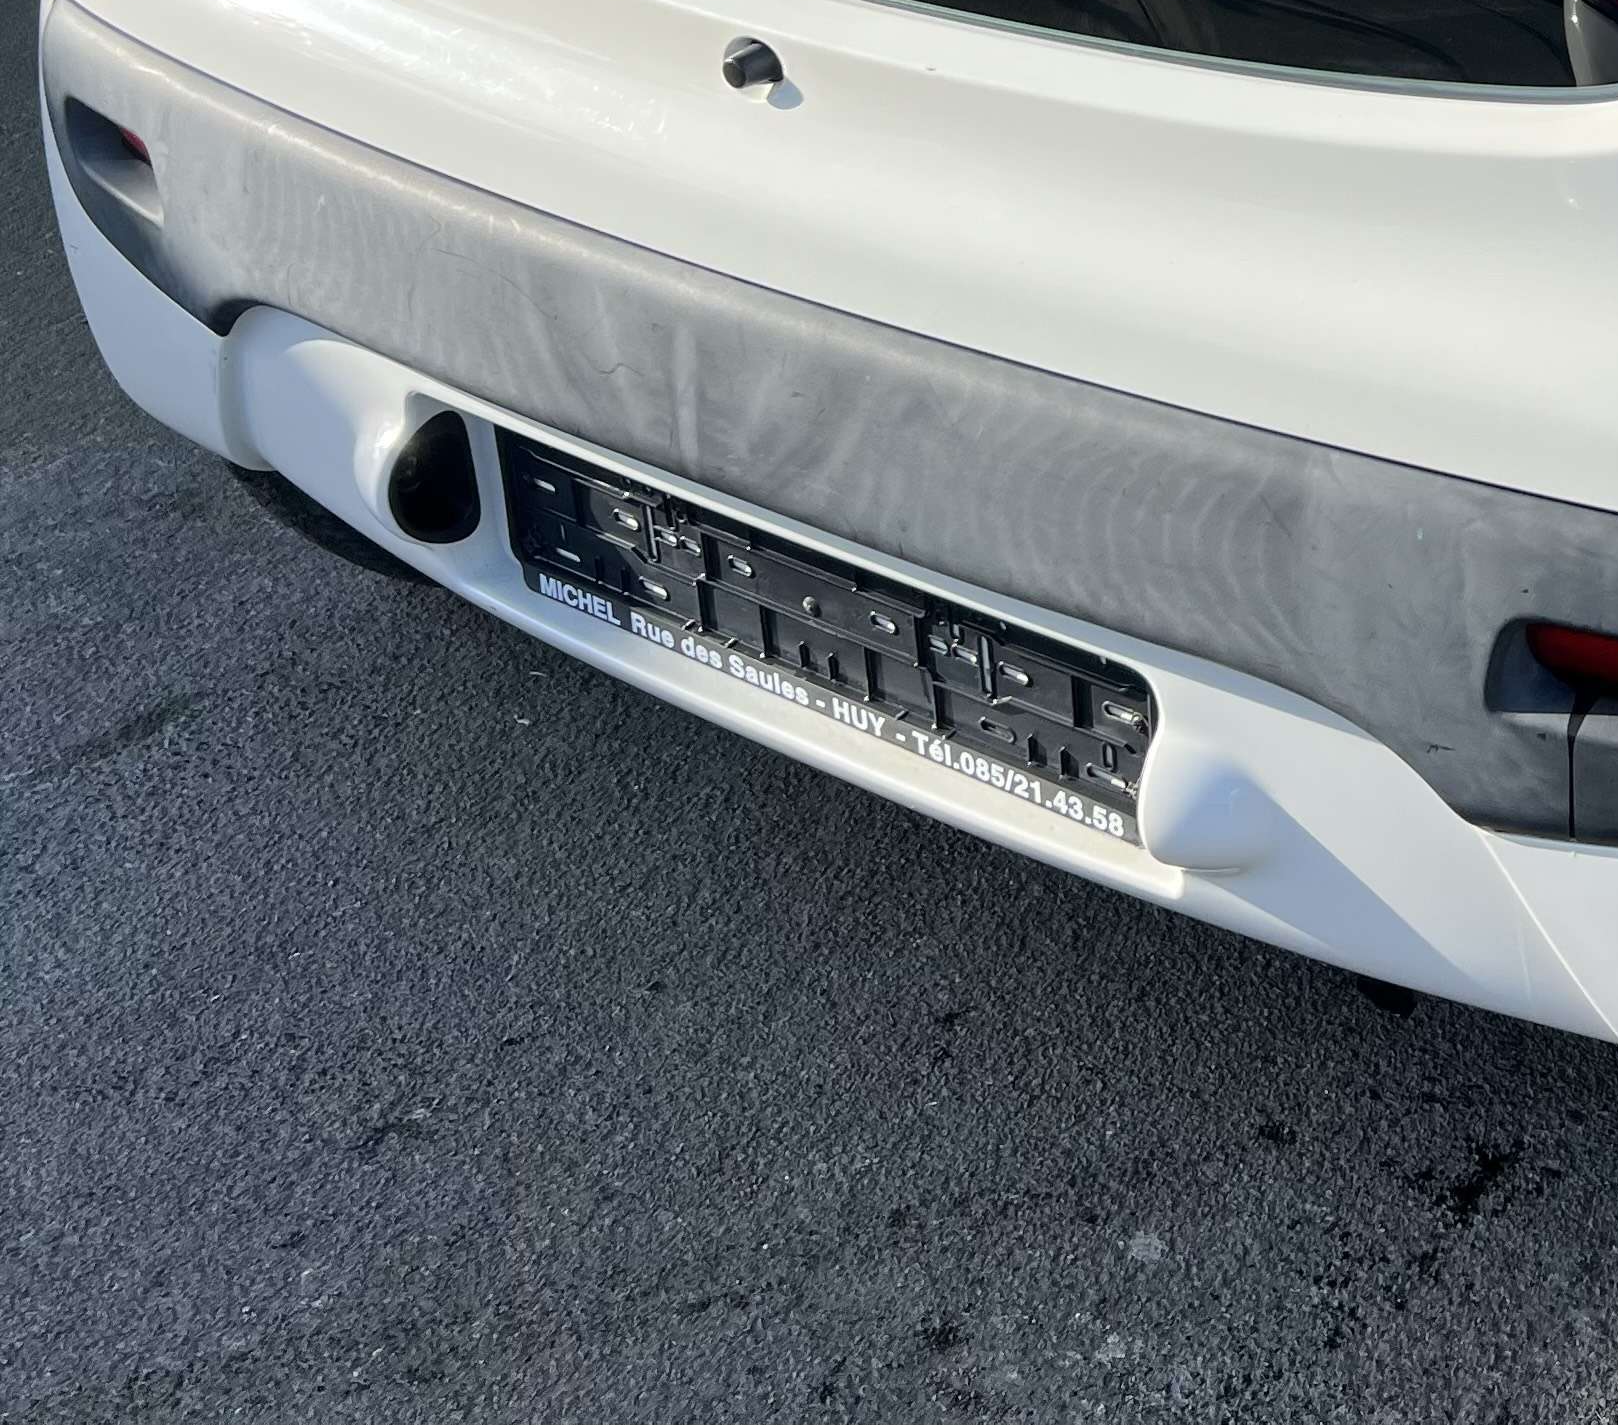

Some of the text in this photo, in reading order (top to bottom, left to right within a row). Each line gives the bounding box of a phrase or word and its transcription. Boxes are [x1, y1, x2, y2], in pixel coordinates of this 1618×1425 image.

[539, 573, 621, 626] MICHEL
[630, 612, 675, 649] Rue
[681, 636, 722, 668] des
[729, 654, 809, 707] Saules
[832, 698, 886, 736] HUY
